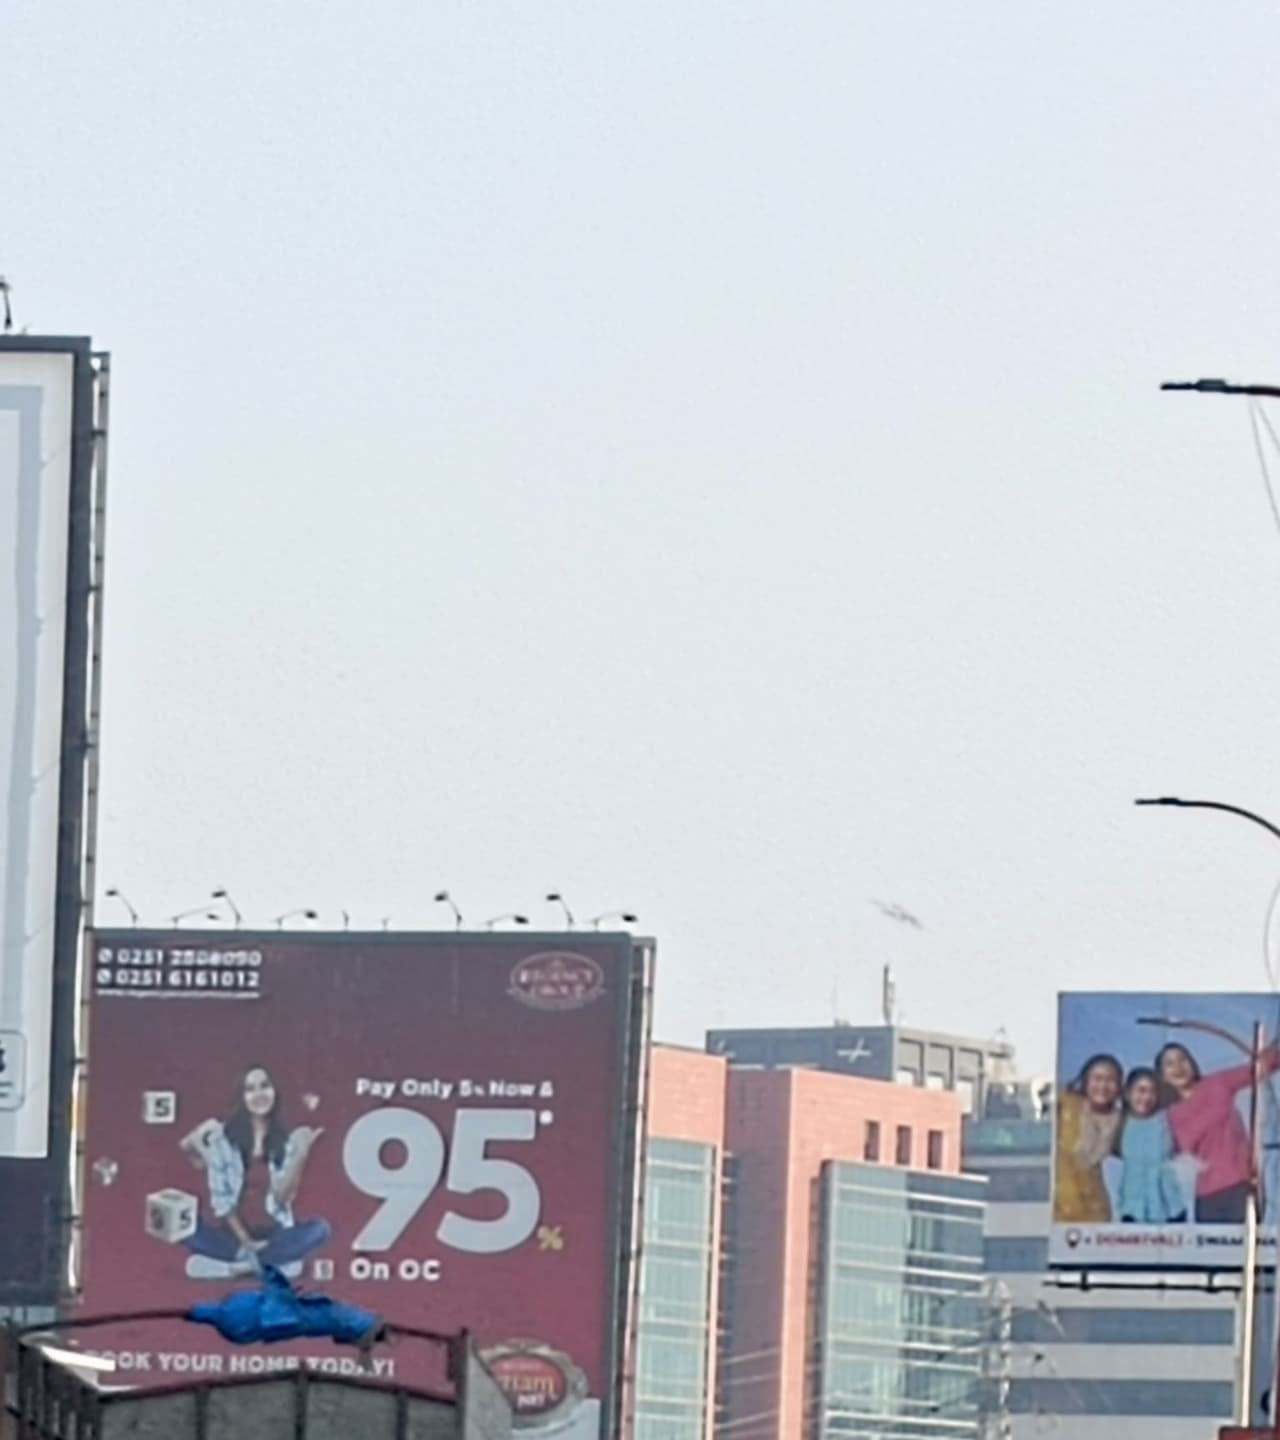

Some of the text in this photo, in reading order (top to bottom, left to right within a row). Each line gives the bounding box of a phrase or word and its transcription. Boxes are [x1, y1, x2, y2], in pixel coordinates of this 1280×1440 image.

[356, 1077, 396, 1099] Pay
[401, 1078, 453, 1099] Only
[489, 1080, 536, 1097] Now
[349, 1256, 441, 1282] On OC
[158, 1352, 223, 1373] YOUR
[229, 1354, 299, 1374] HOME
